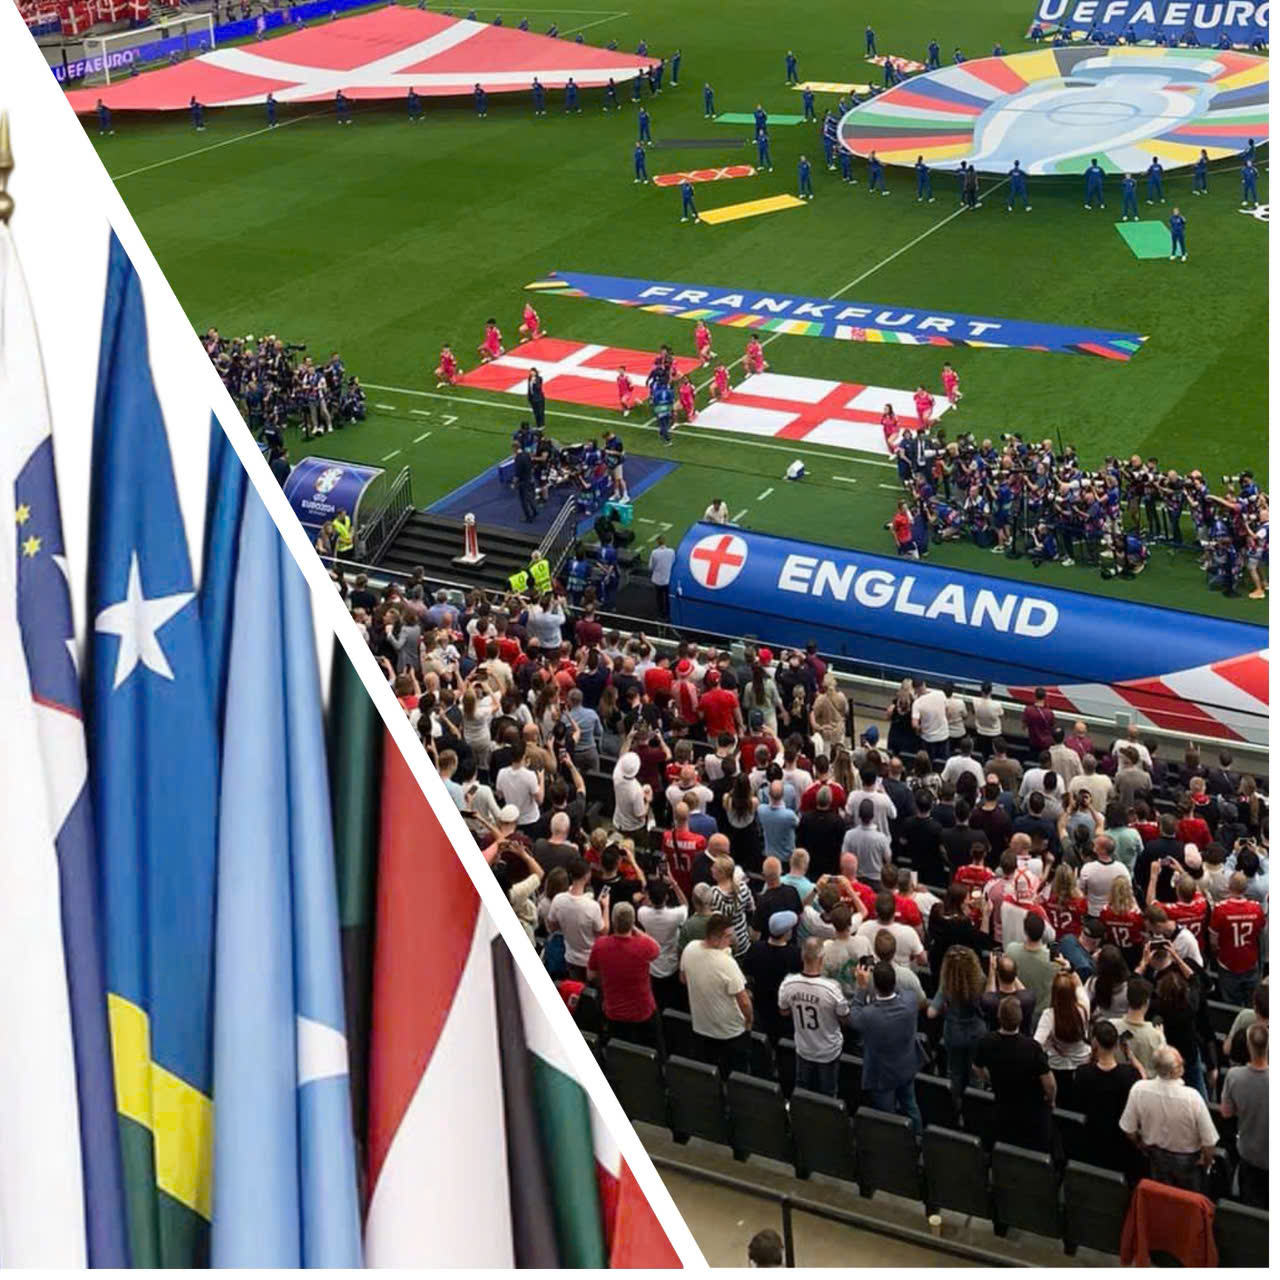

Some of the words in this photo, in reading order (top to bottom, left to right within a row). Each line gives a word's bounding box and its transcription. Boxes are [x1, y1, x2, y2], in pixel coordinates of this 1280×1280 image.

[639, 285, 1002, 336] FRANKFURT
[777, 553, 1060, 638] ENGLAND
[1111, 927, 1133, 948] 12
[1232, 922, 1253, 948] 12
[796, 1004, 820, 1030] 13
